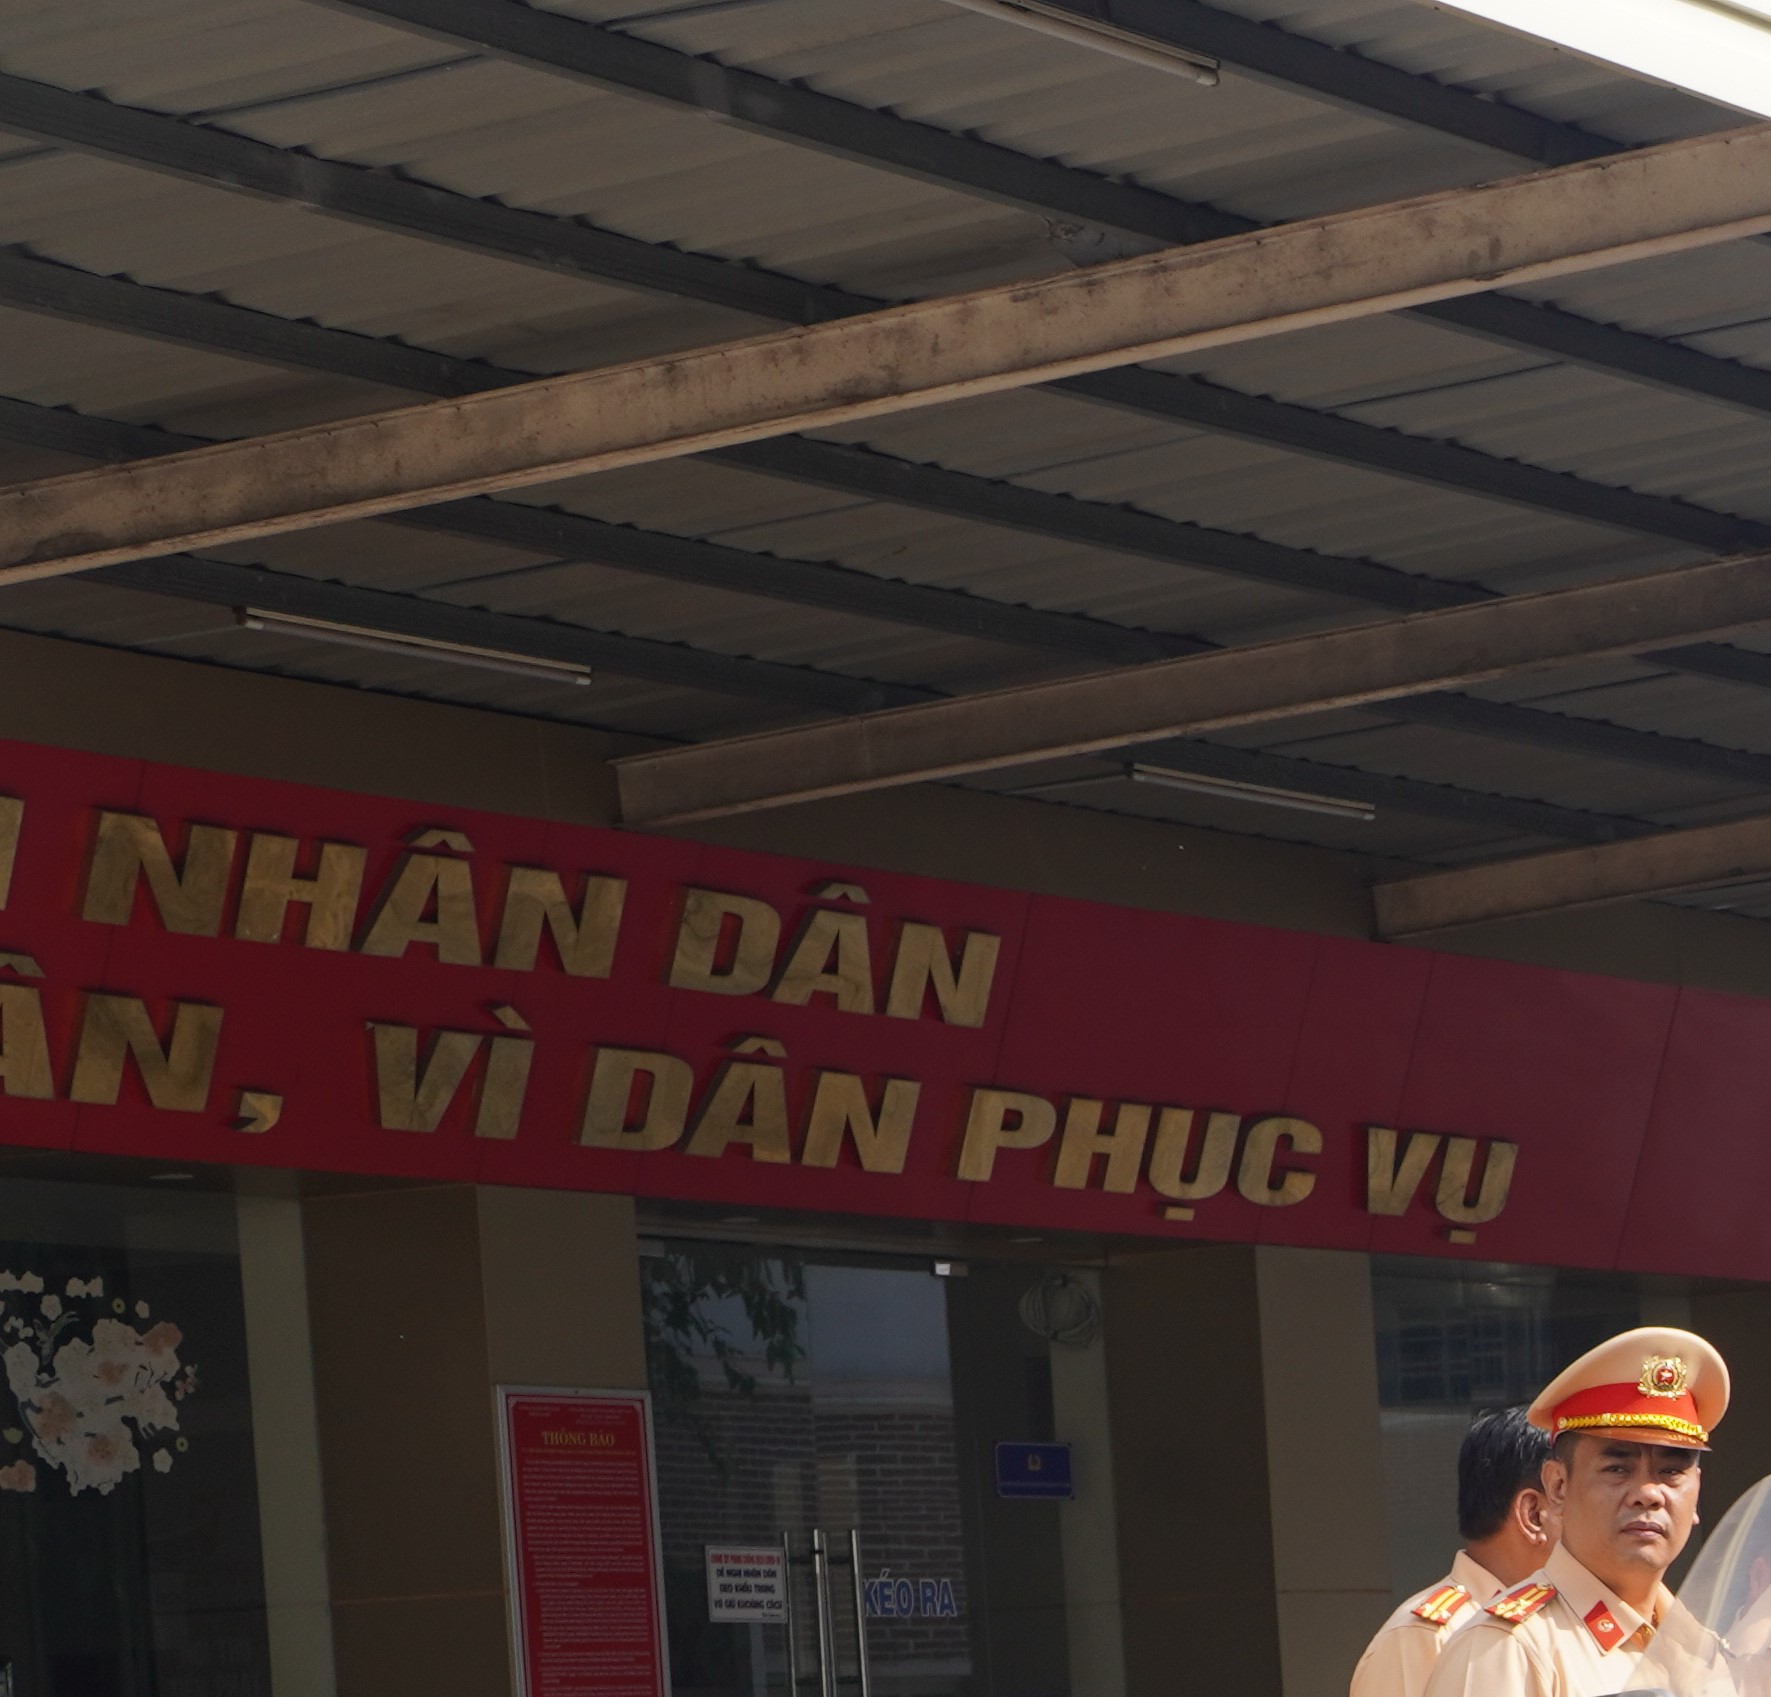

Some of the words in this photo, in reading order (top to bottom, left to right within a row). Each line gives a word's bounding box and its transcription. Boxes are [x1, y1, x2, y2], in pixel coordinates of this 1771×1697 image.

[80, 828, 628, 980] NHÂN
[669, 882, 1000, 1028] DÂN
[368, 1005, 535, 1141] VÌ
[579, 1036, 923, 1176] DÂN
[957, 1087, 1324, 1222] PHỤC
[1366, 1127, 1519, 1245] VỤ
[863, 1568, 915, 1617] KÉO
[920, 1578, 958, 1617] RA
